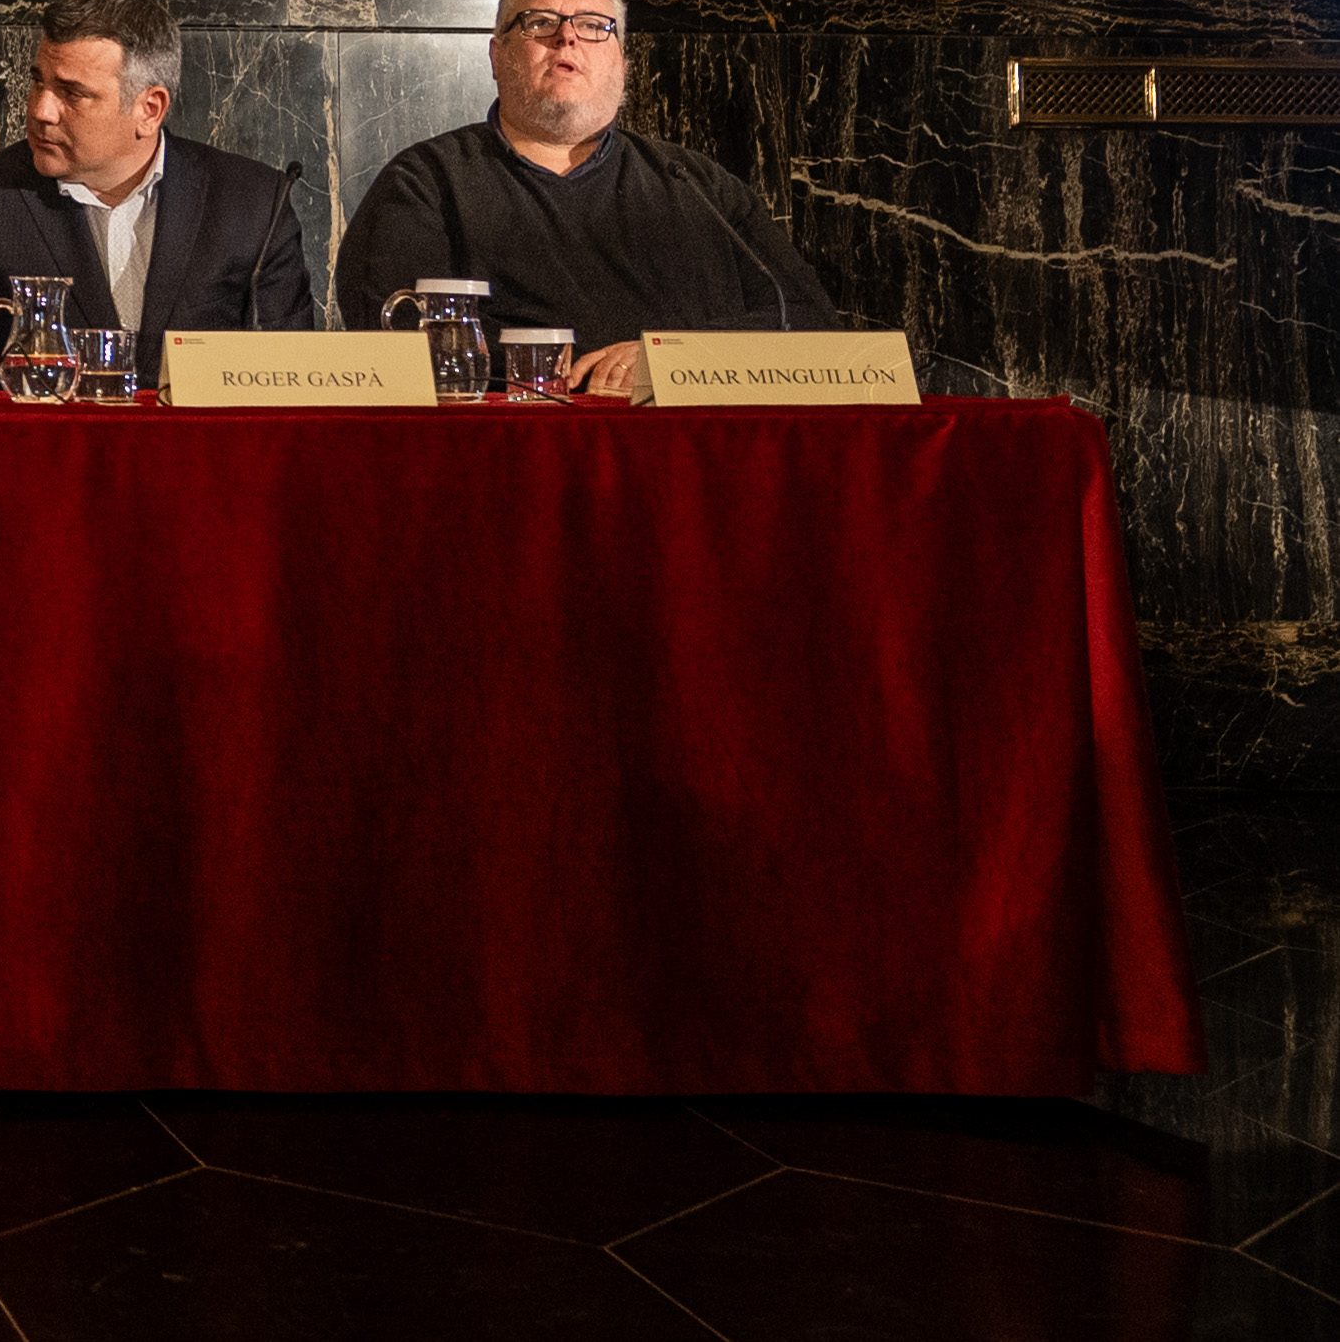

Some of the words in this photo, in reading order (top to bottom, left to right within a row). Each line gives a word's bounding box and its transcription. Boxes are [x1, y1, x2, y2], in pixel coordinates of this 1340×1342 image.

[221, 370, 302, 387] ROGER
[307, 366, 385, 388] GASPÀ
[669, 369, 742, 386] OMAR
[746, 363, 897, 385] MINGUILLÓN
